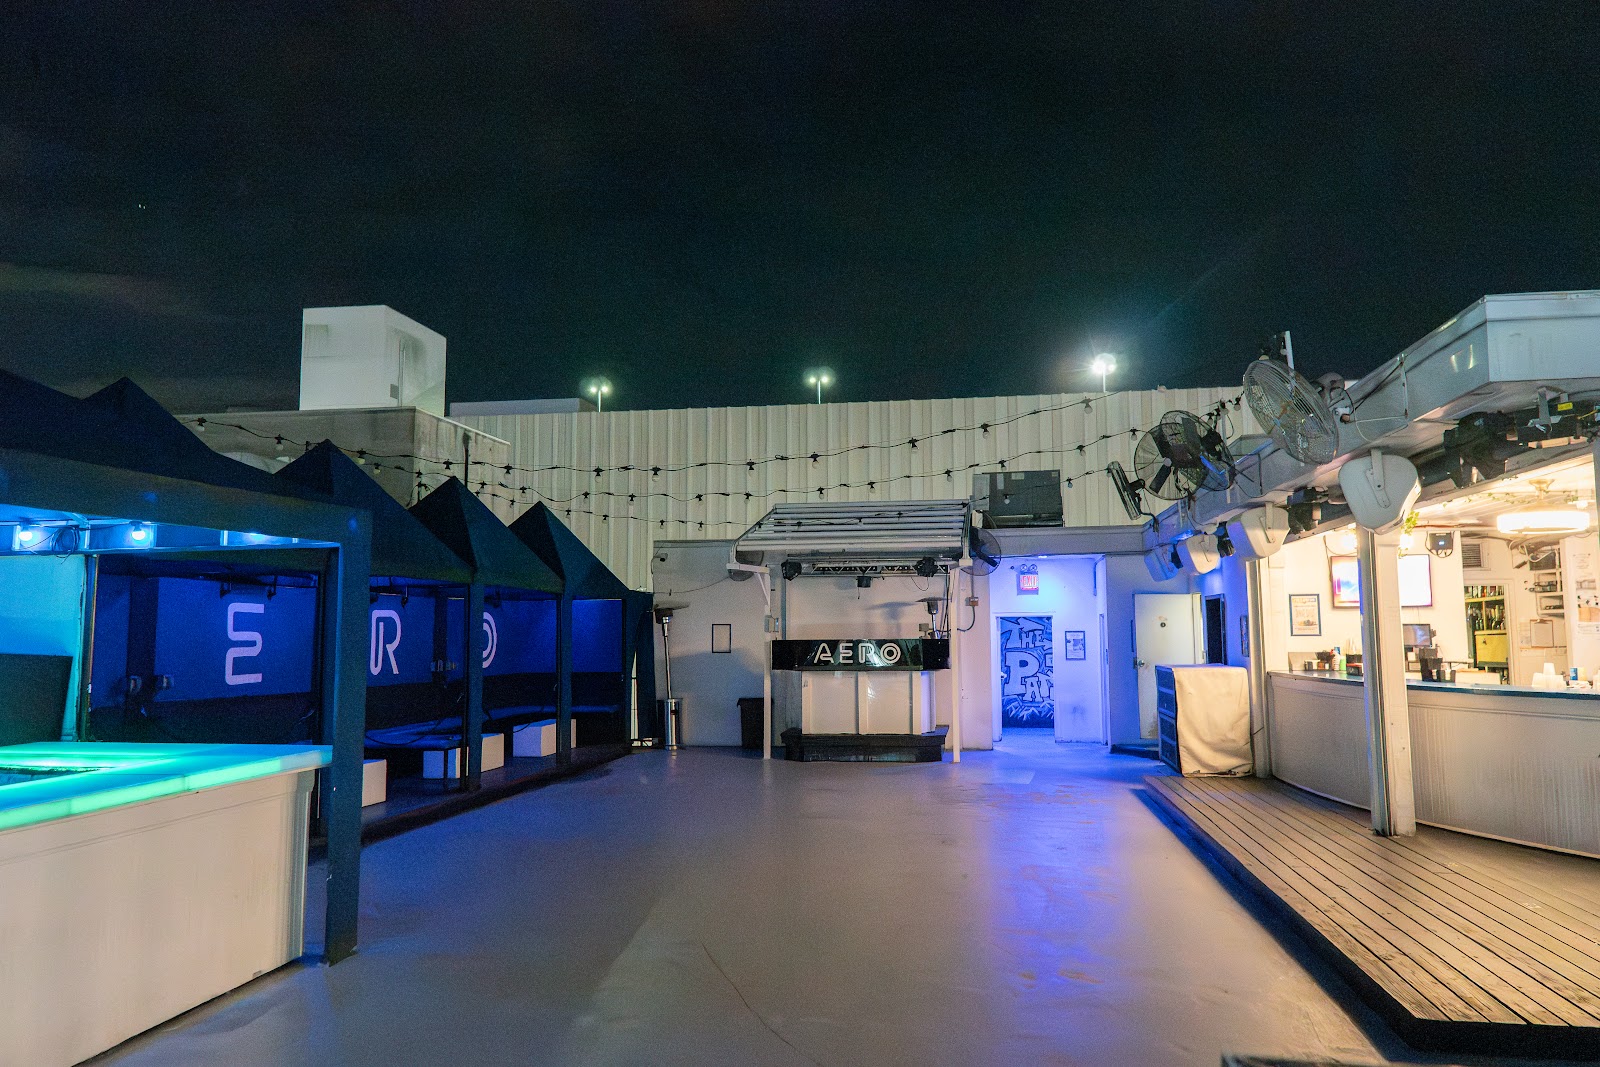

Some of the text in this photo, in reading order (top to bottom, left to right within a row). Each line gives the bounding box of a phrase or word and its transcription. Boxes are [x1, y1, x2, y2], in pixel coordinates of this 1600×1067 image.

[1022, 575, 1037, 586] EXIT
[225, 602, 265, 686] E
[369, 609, 402, 675] R
[813, 642, 902, 664] AERO
